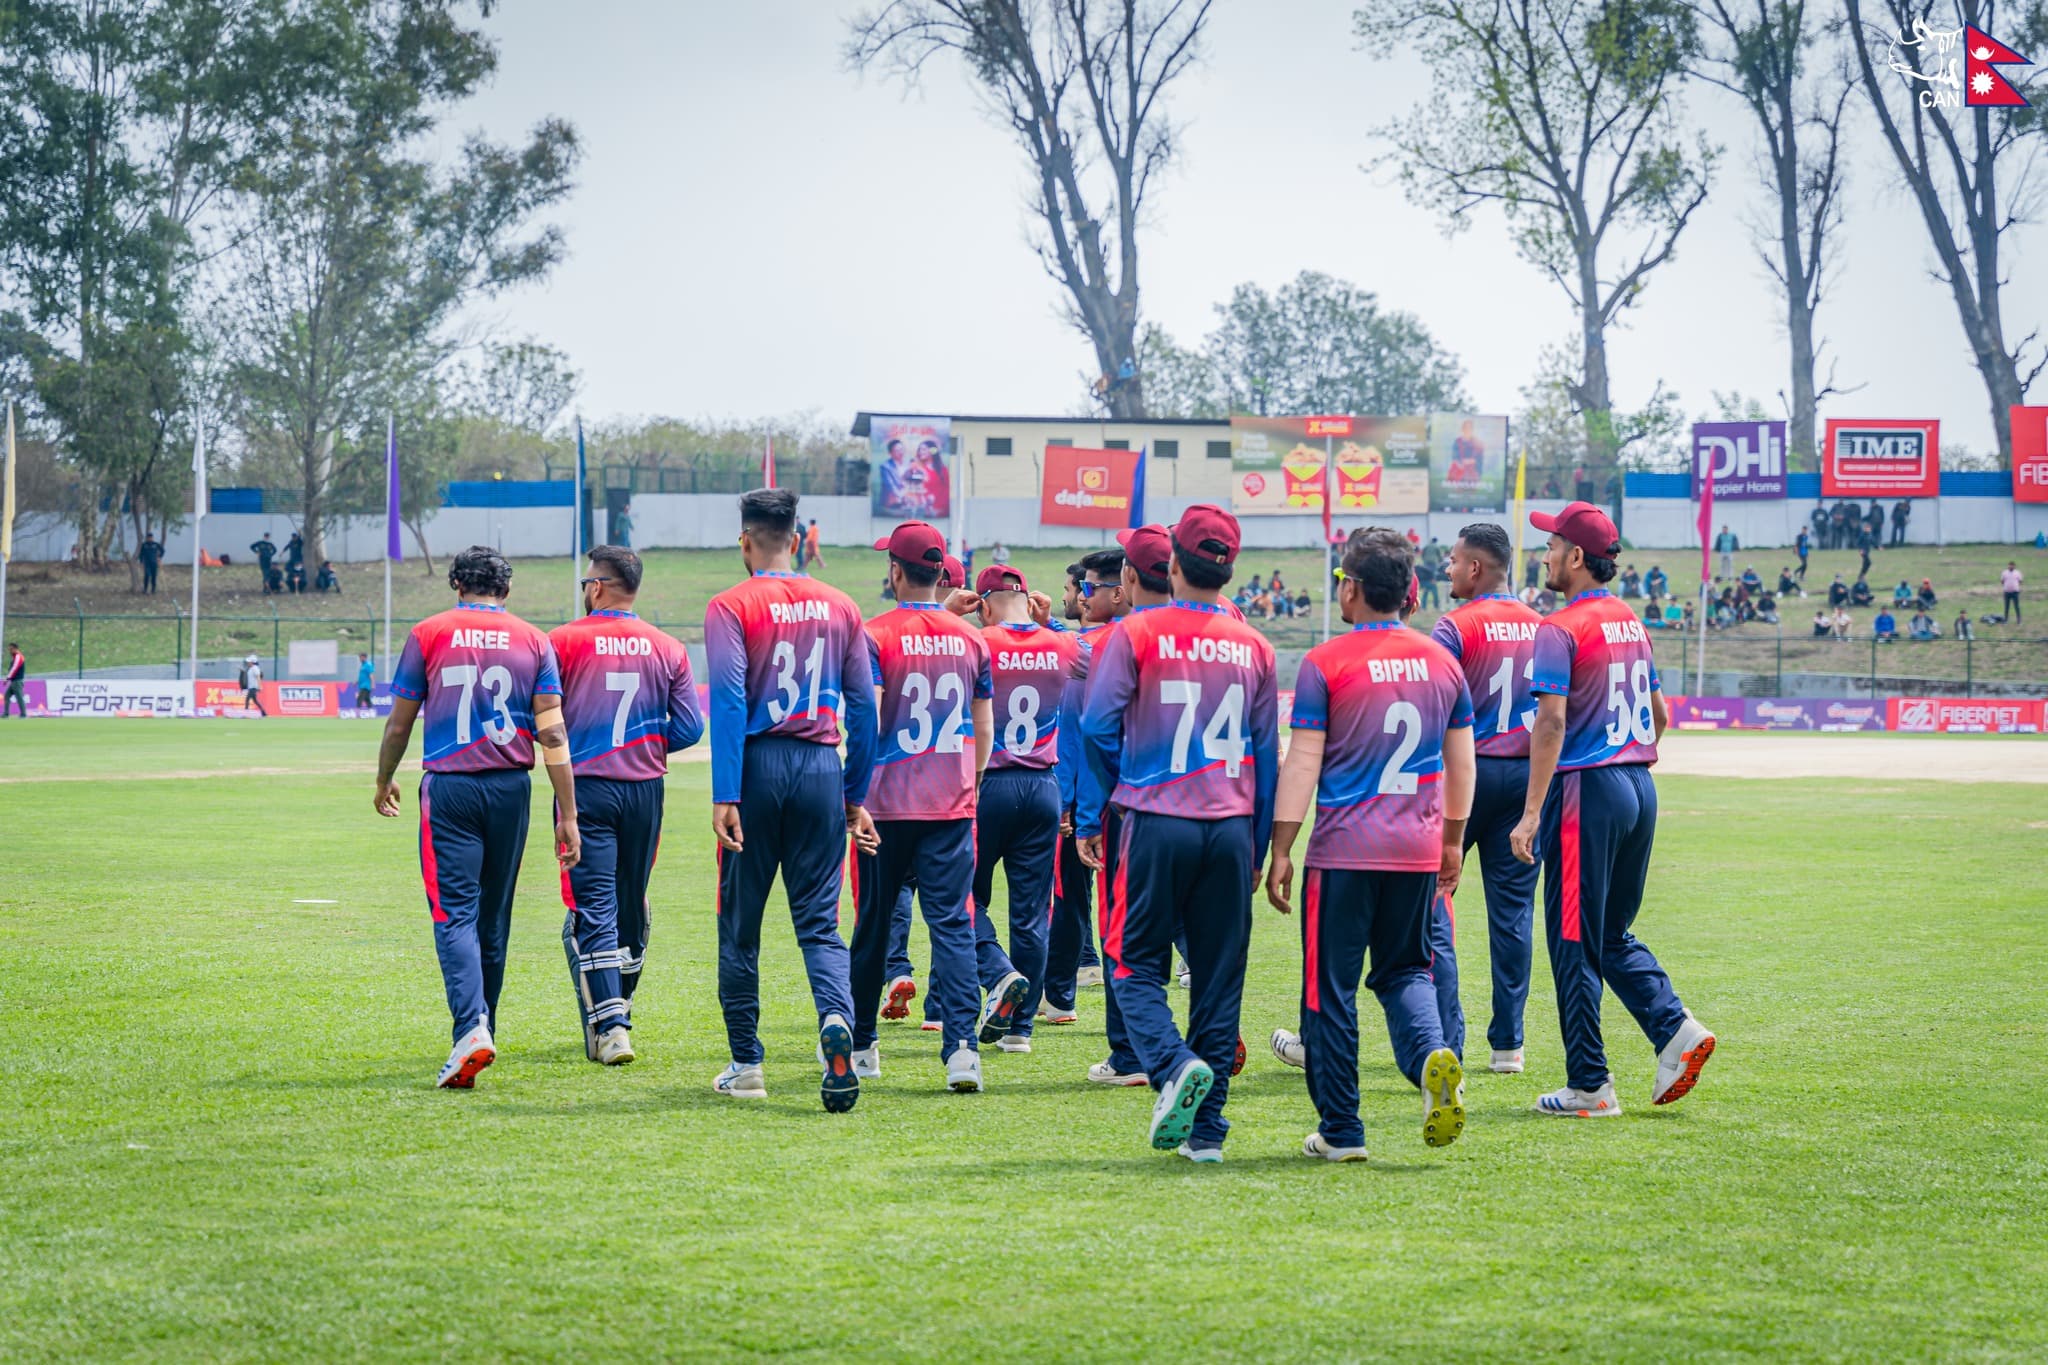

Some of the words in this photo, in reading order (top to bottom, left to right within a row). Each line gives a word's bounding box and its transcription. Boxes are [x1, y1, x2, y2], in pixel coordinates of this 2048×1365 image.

[1851, 436, 1918, 459] IME
[1700, 482, 1744, 496] ppier
[1747, 481, 1781, 493] Home
[769, 600, 829, 624] PAWAN
[451, 628, 510, 650] AIREE
[1600, 620, 1647, 644] BIKASH
[595, 636, 651, 656] BINOD
[901, 634, 966, 657] RASHID
[1158, 635, 1182, 659] N.
[1187, 636, 1251, 669] JOSHI
[998, 651, 1059, 671] SAGAR
[1368, 657, 1429, 683] BIPIN
[63, 684, 108, 693] ACTION
[767, 637, 825, 724] 31
[61, 696, 153, 711] SPORTS
[176, 697, 185, 708] 1
[441, 665, 516, 745] 73
[606, 672, 640, 747] 7
[898, 672, 965, 754] 32
[1606, 660, 1656, 746] 58
[1940, 706, 2022, 724] FIBERNET
[1004, 685, 1040, 756] 8
[1160, 680, 1246, 778] 74
[1377, 701, 1424, 795] 2
